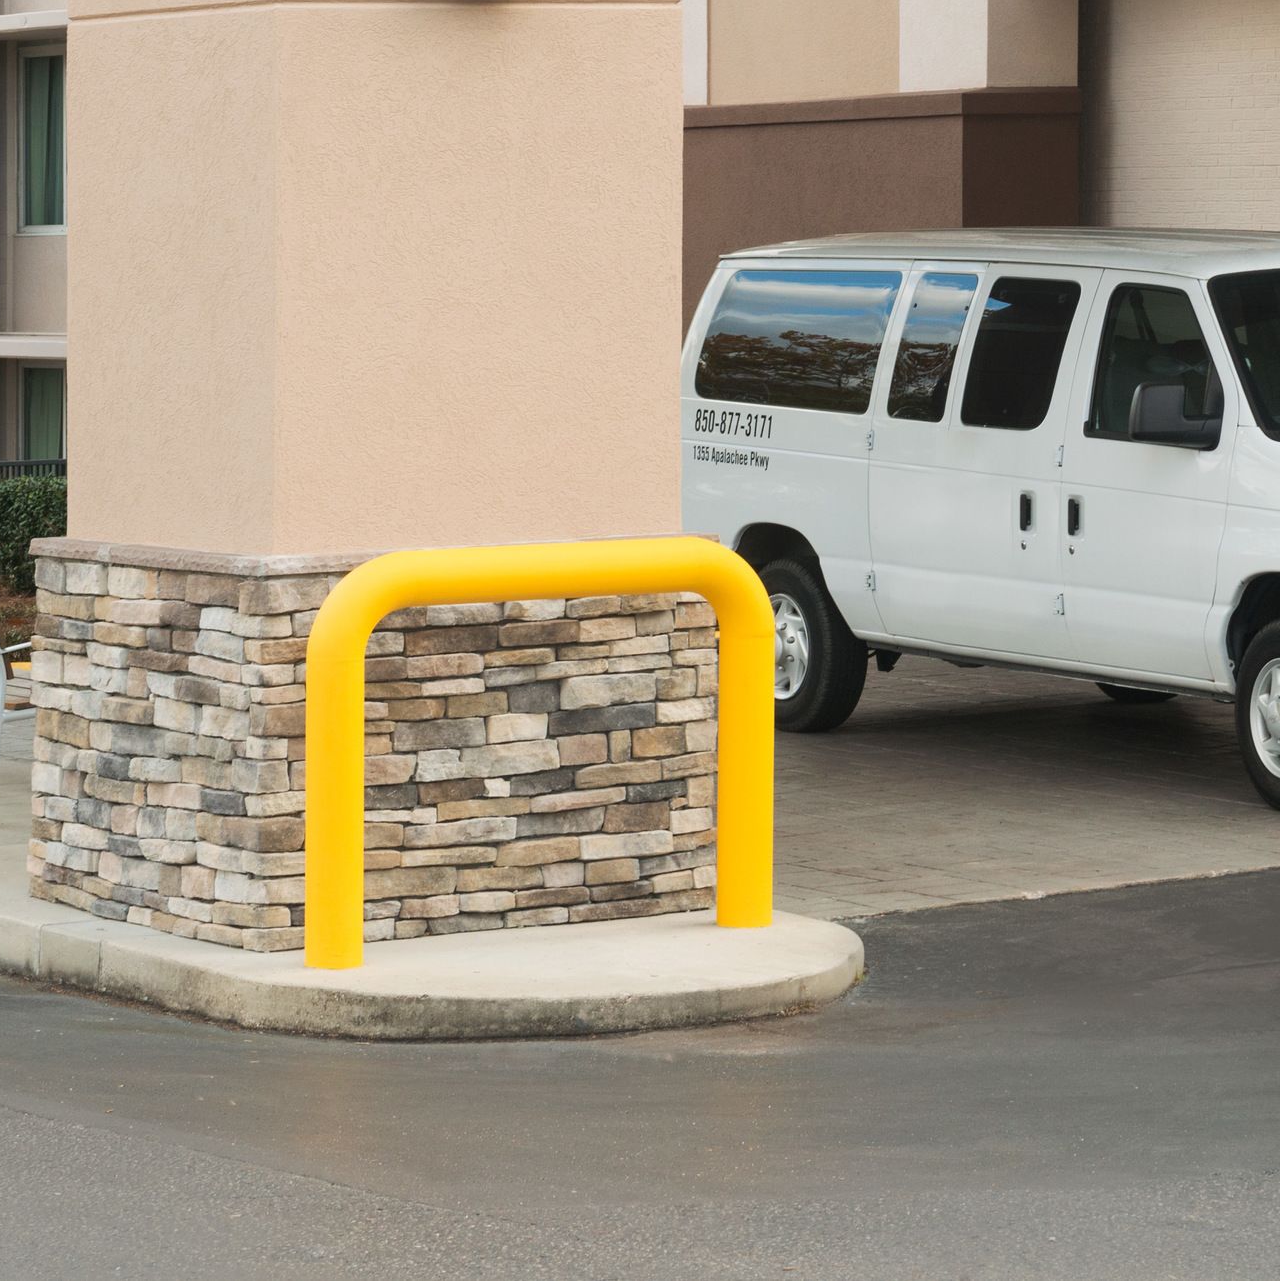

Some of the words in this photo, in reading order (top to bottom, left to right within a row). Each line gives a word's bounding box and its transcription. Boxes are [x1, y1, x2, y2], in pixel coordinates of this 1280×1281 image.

[694, 408, 773, 439] 850-877-3171
[693, 445, 710, 462] 1355
[710, 447, 749, 466] Apalachee
[750, 451, 770, 471] Pkwy
